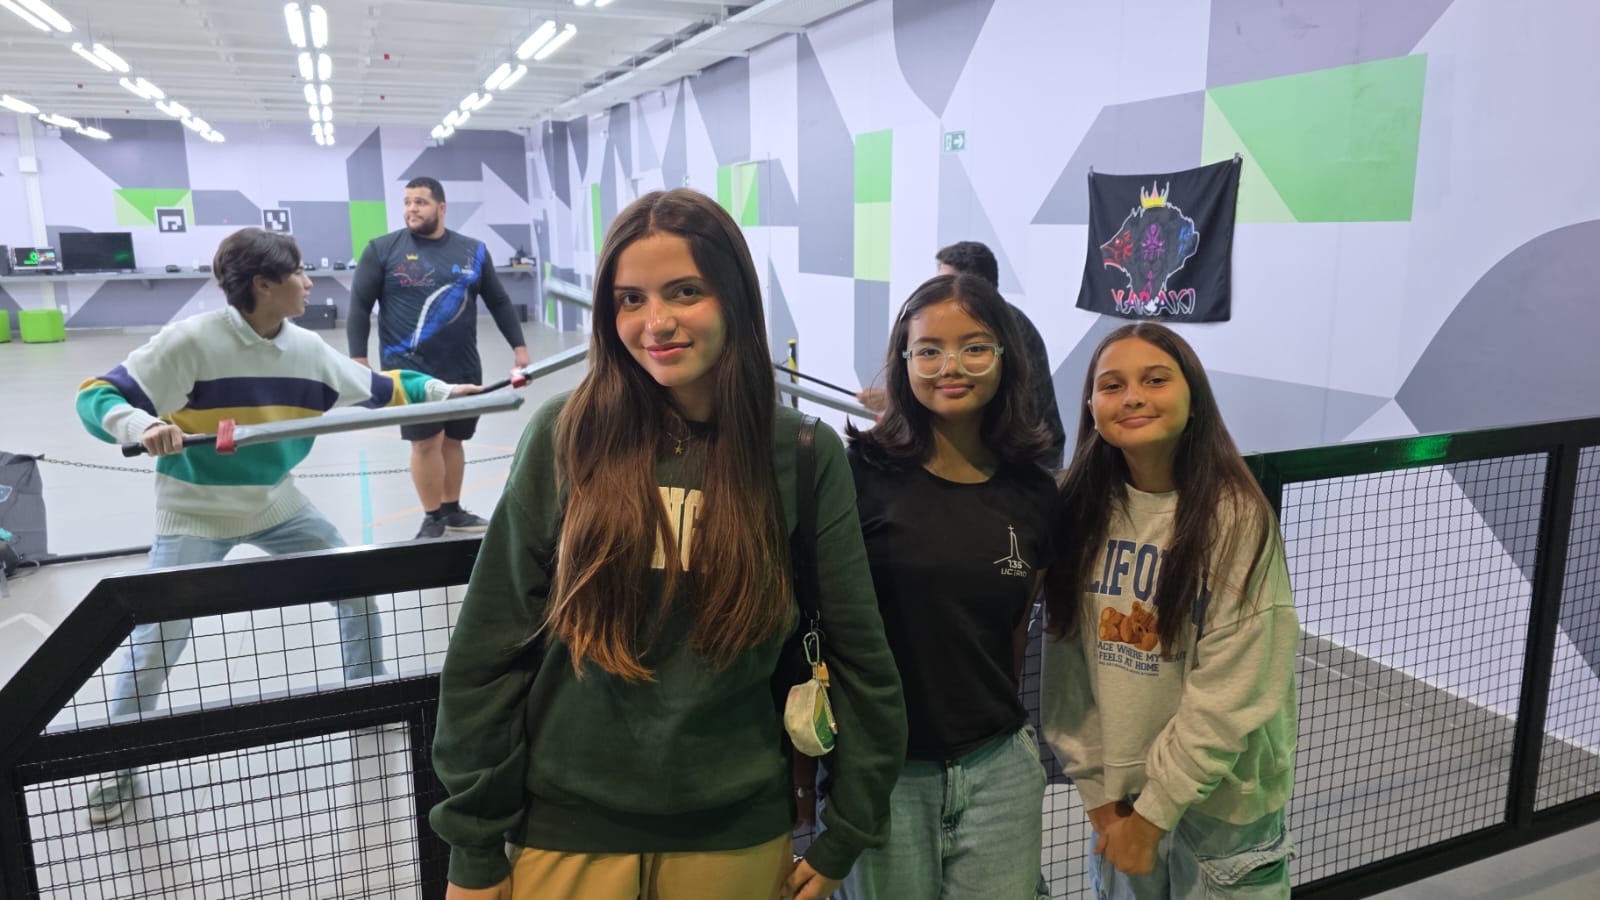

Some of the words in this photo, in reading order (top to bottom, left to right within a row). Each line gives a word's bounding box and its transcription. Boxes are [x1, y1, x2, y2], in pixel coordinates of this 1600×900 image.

[1099, 651, 1123, 663] FEELS
[1124, 657, 1133, 667] AT
[1135, 660, 1160, 672] HOME
[1117, 643, 1144, 661] WHERE
[1145, 652, 1160, 662] MY
